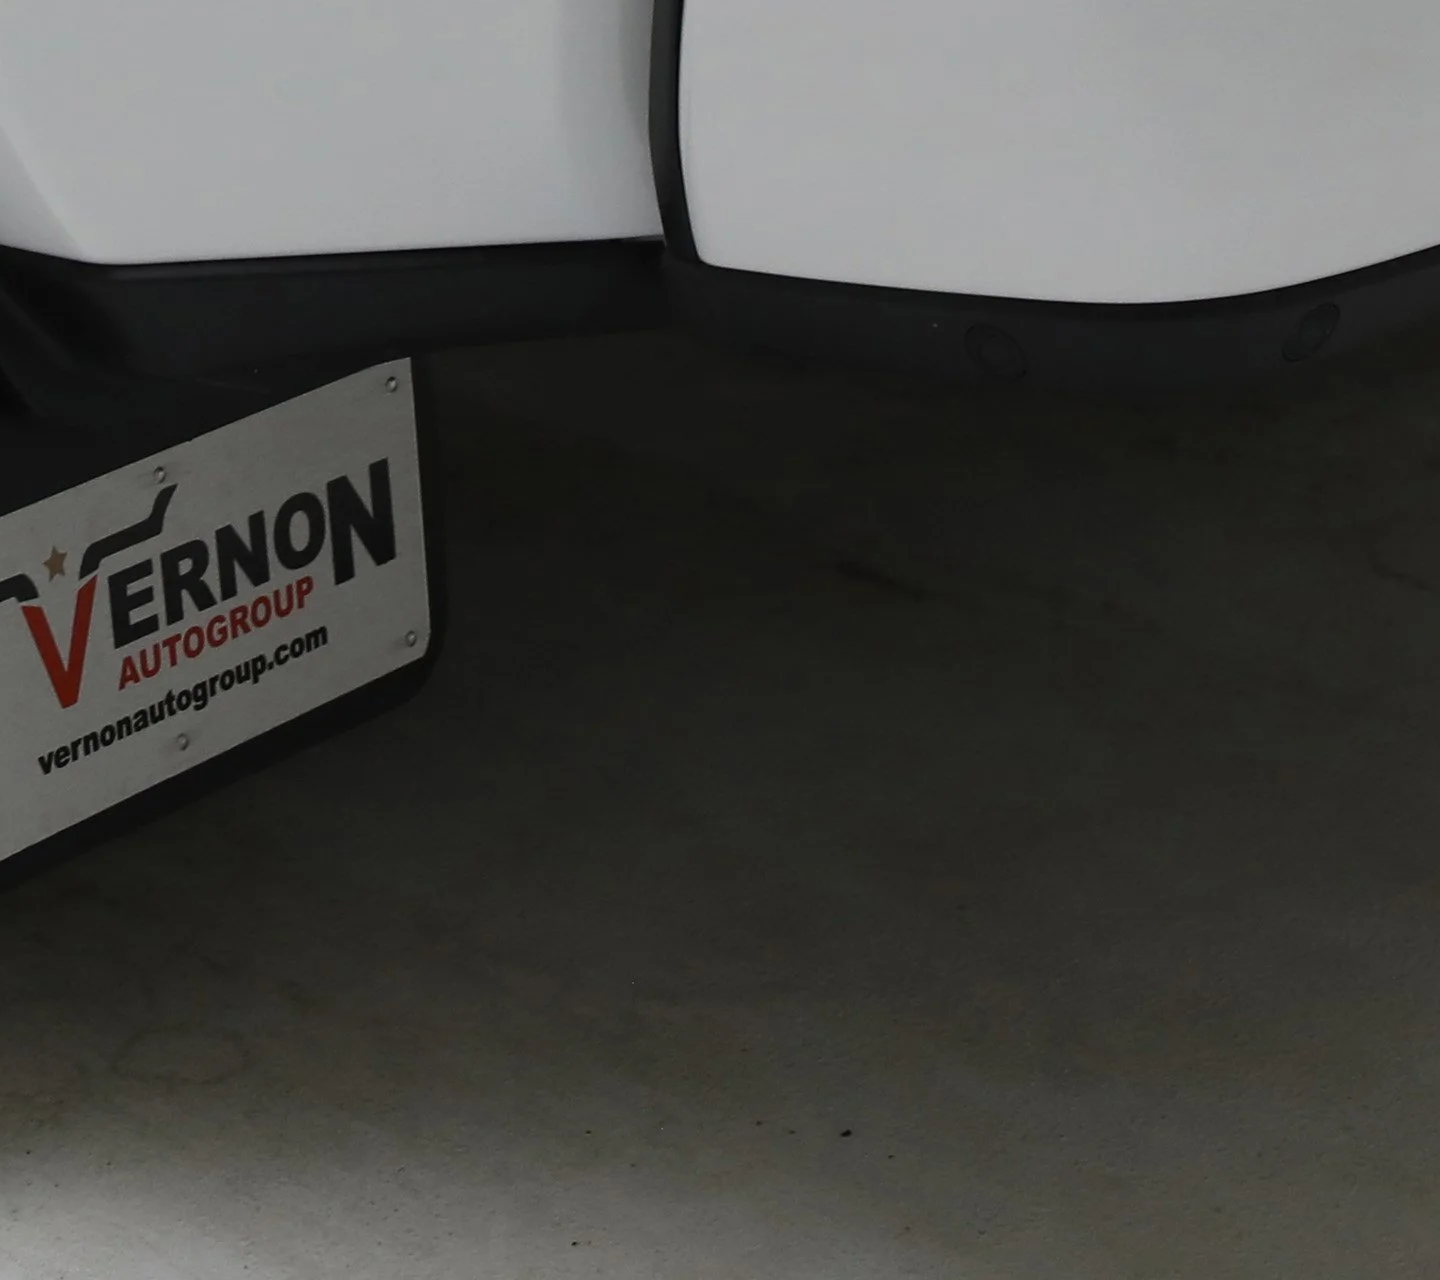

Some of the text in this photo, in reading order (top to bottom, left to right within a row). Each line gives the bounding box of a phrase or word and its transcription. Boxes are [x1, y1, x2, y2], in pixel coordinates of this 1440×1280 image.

[20, 457, 397, 709] VERNON
[119, 575, 315, 691] AUTOGROUP
[37, 622, 329, 775] vernonautogroup.com
